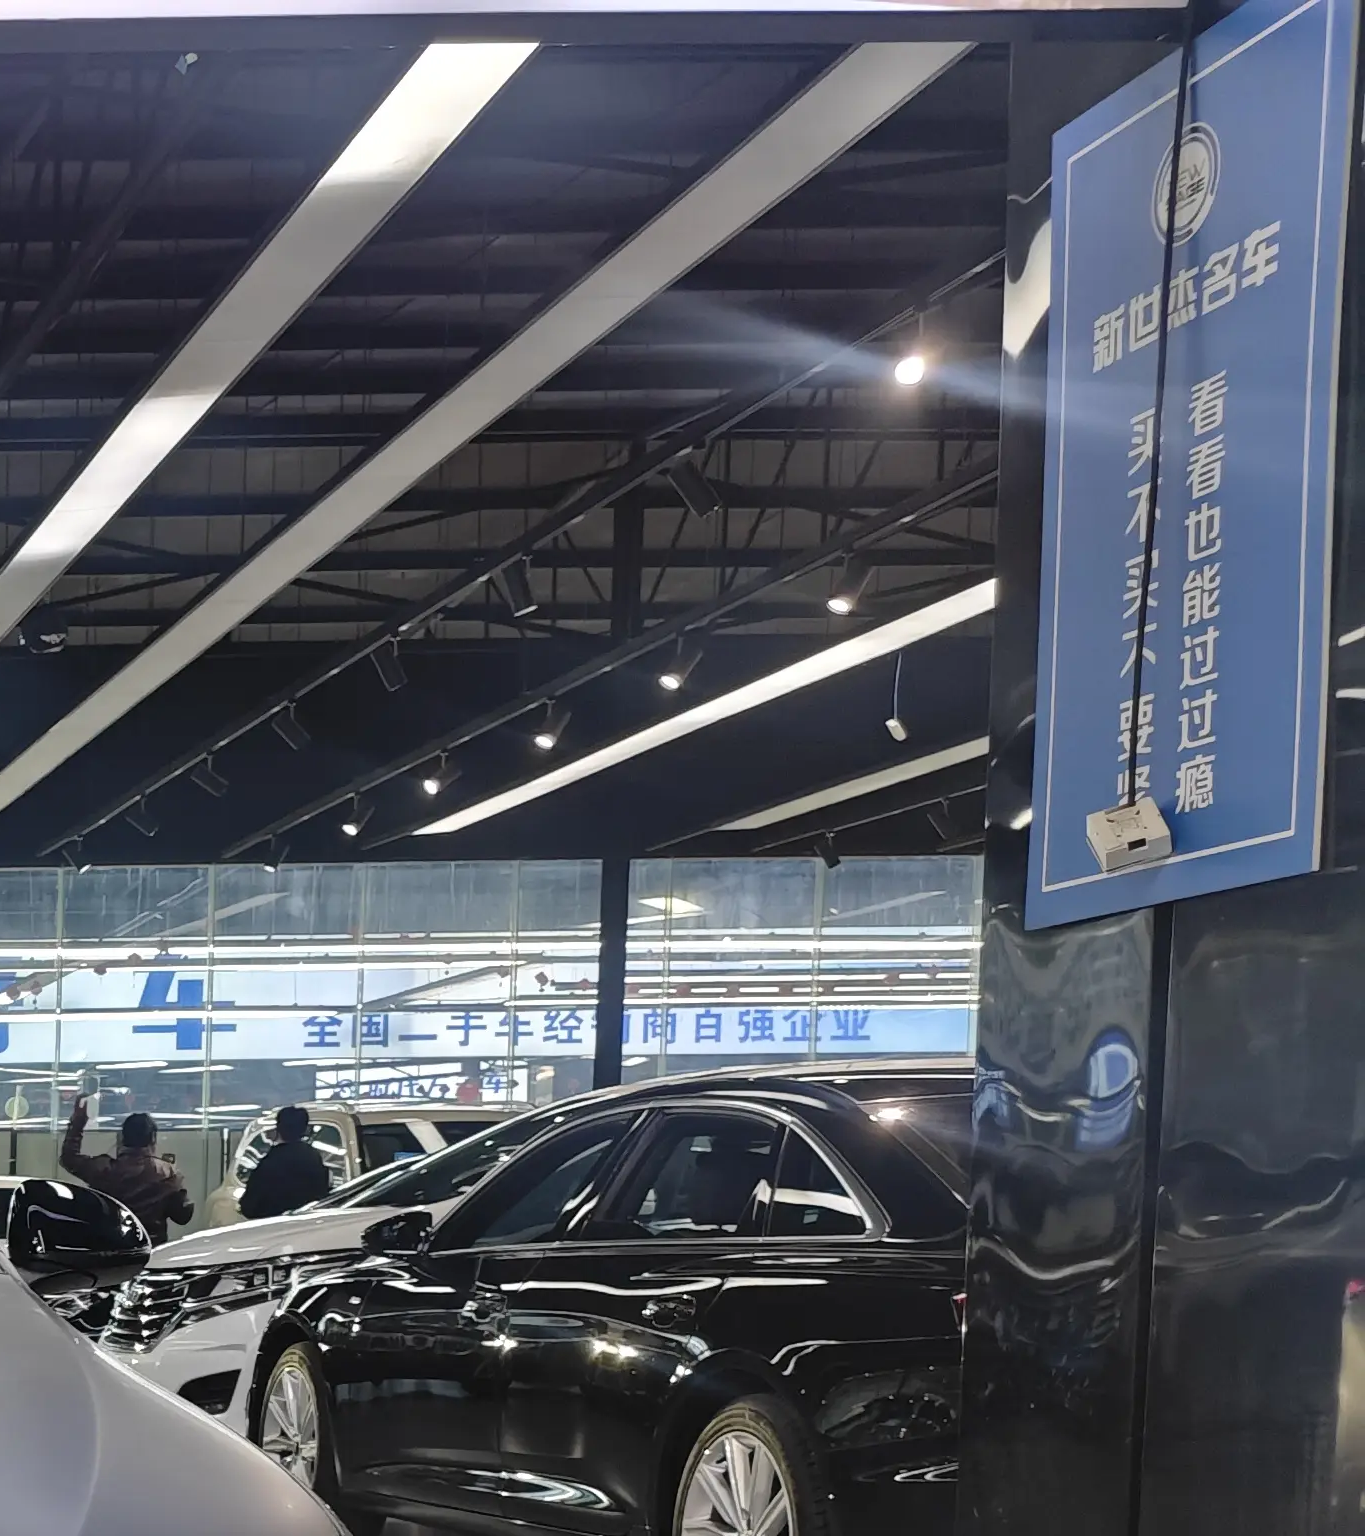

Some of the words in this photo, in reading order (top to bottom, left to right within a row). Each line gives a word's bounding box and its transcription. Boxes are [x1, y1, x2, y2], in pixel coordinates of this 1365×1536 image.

[1093, 220, 1281, 373] 新世杰名车
[1175, 369, 1229, 814] 看看也能过过瘾
[302, 1008, 871, 1048] 全国二手车经商百强企业
